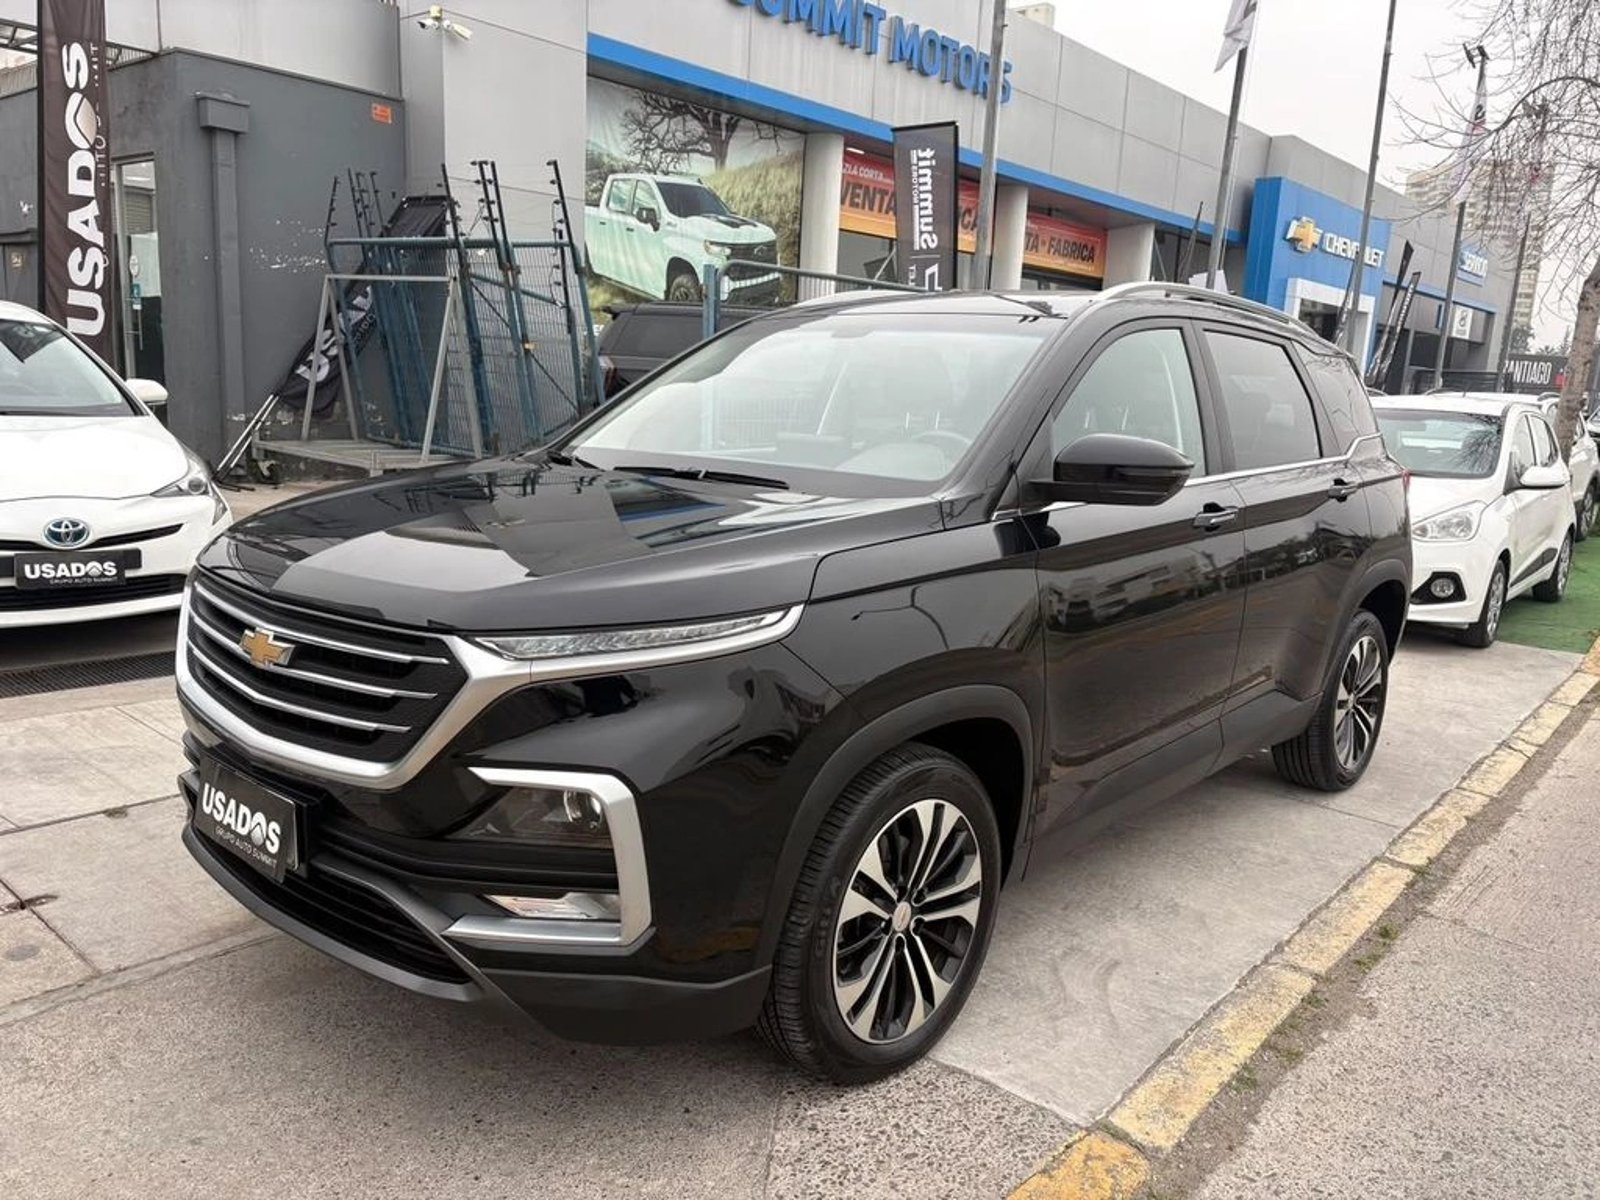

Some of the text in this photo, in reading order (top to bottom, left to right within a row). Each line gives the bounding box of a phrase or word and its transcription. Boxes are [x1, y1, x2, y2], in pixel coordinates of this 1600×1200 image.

[62, 42, 106, 336] USADOS
[24, 561, 118, 579] USADOS
[202, 782, 281, 855] USADOS
